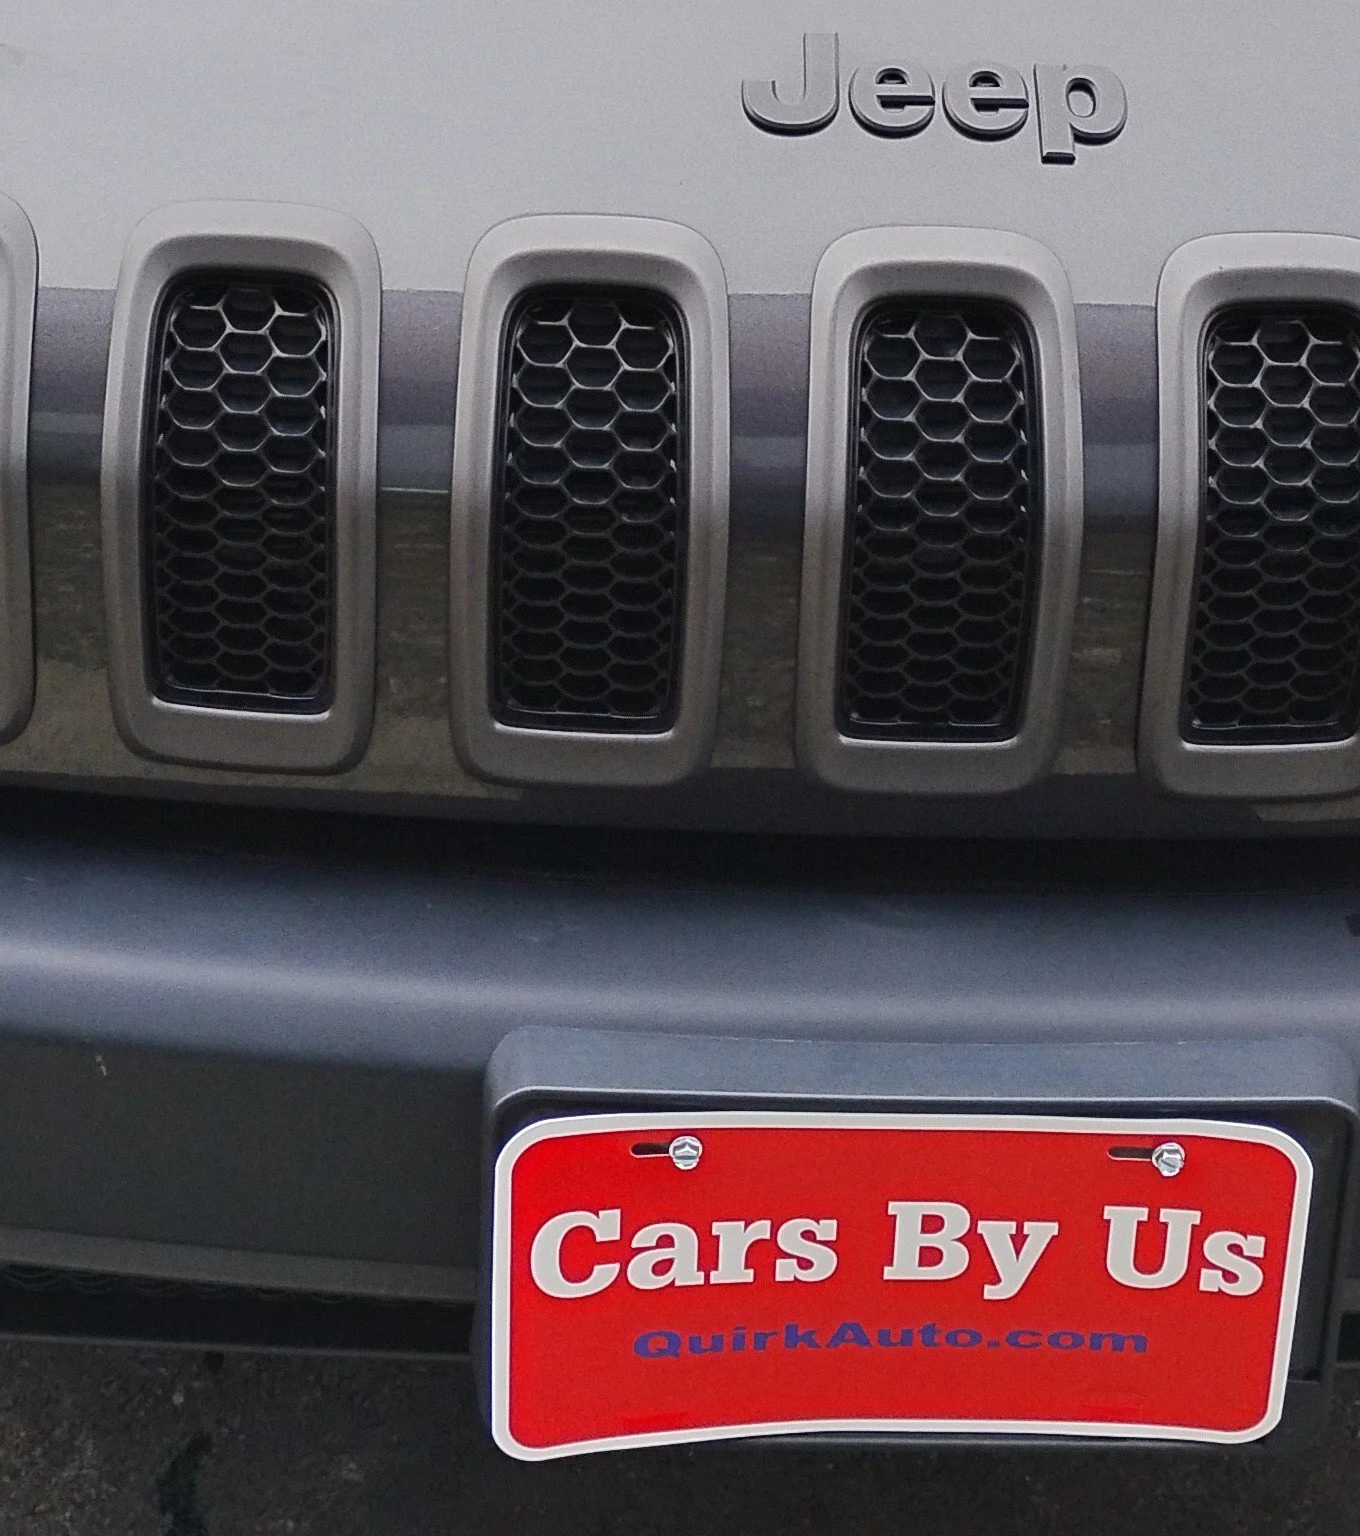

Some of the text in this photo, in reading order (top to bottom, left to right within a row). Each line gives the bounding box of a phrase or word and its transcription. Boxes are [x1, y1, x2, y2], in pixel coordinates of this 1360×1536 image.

[741, 32, 1128, 165] Jeep
[530, 1200, 1266, 1301] Cars By Us
[632, 1320, 1149, 1361] QuirkAuto.com
